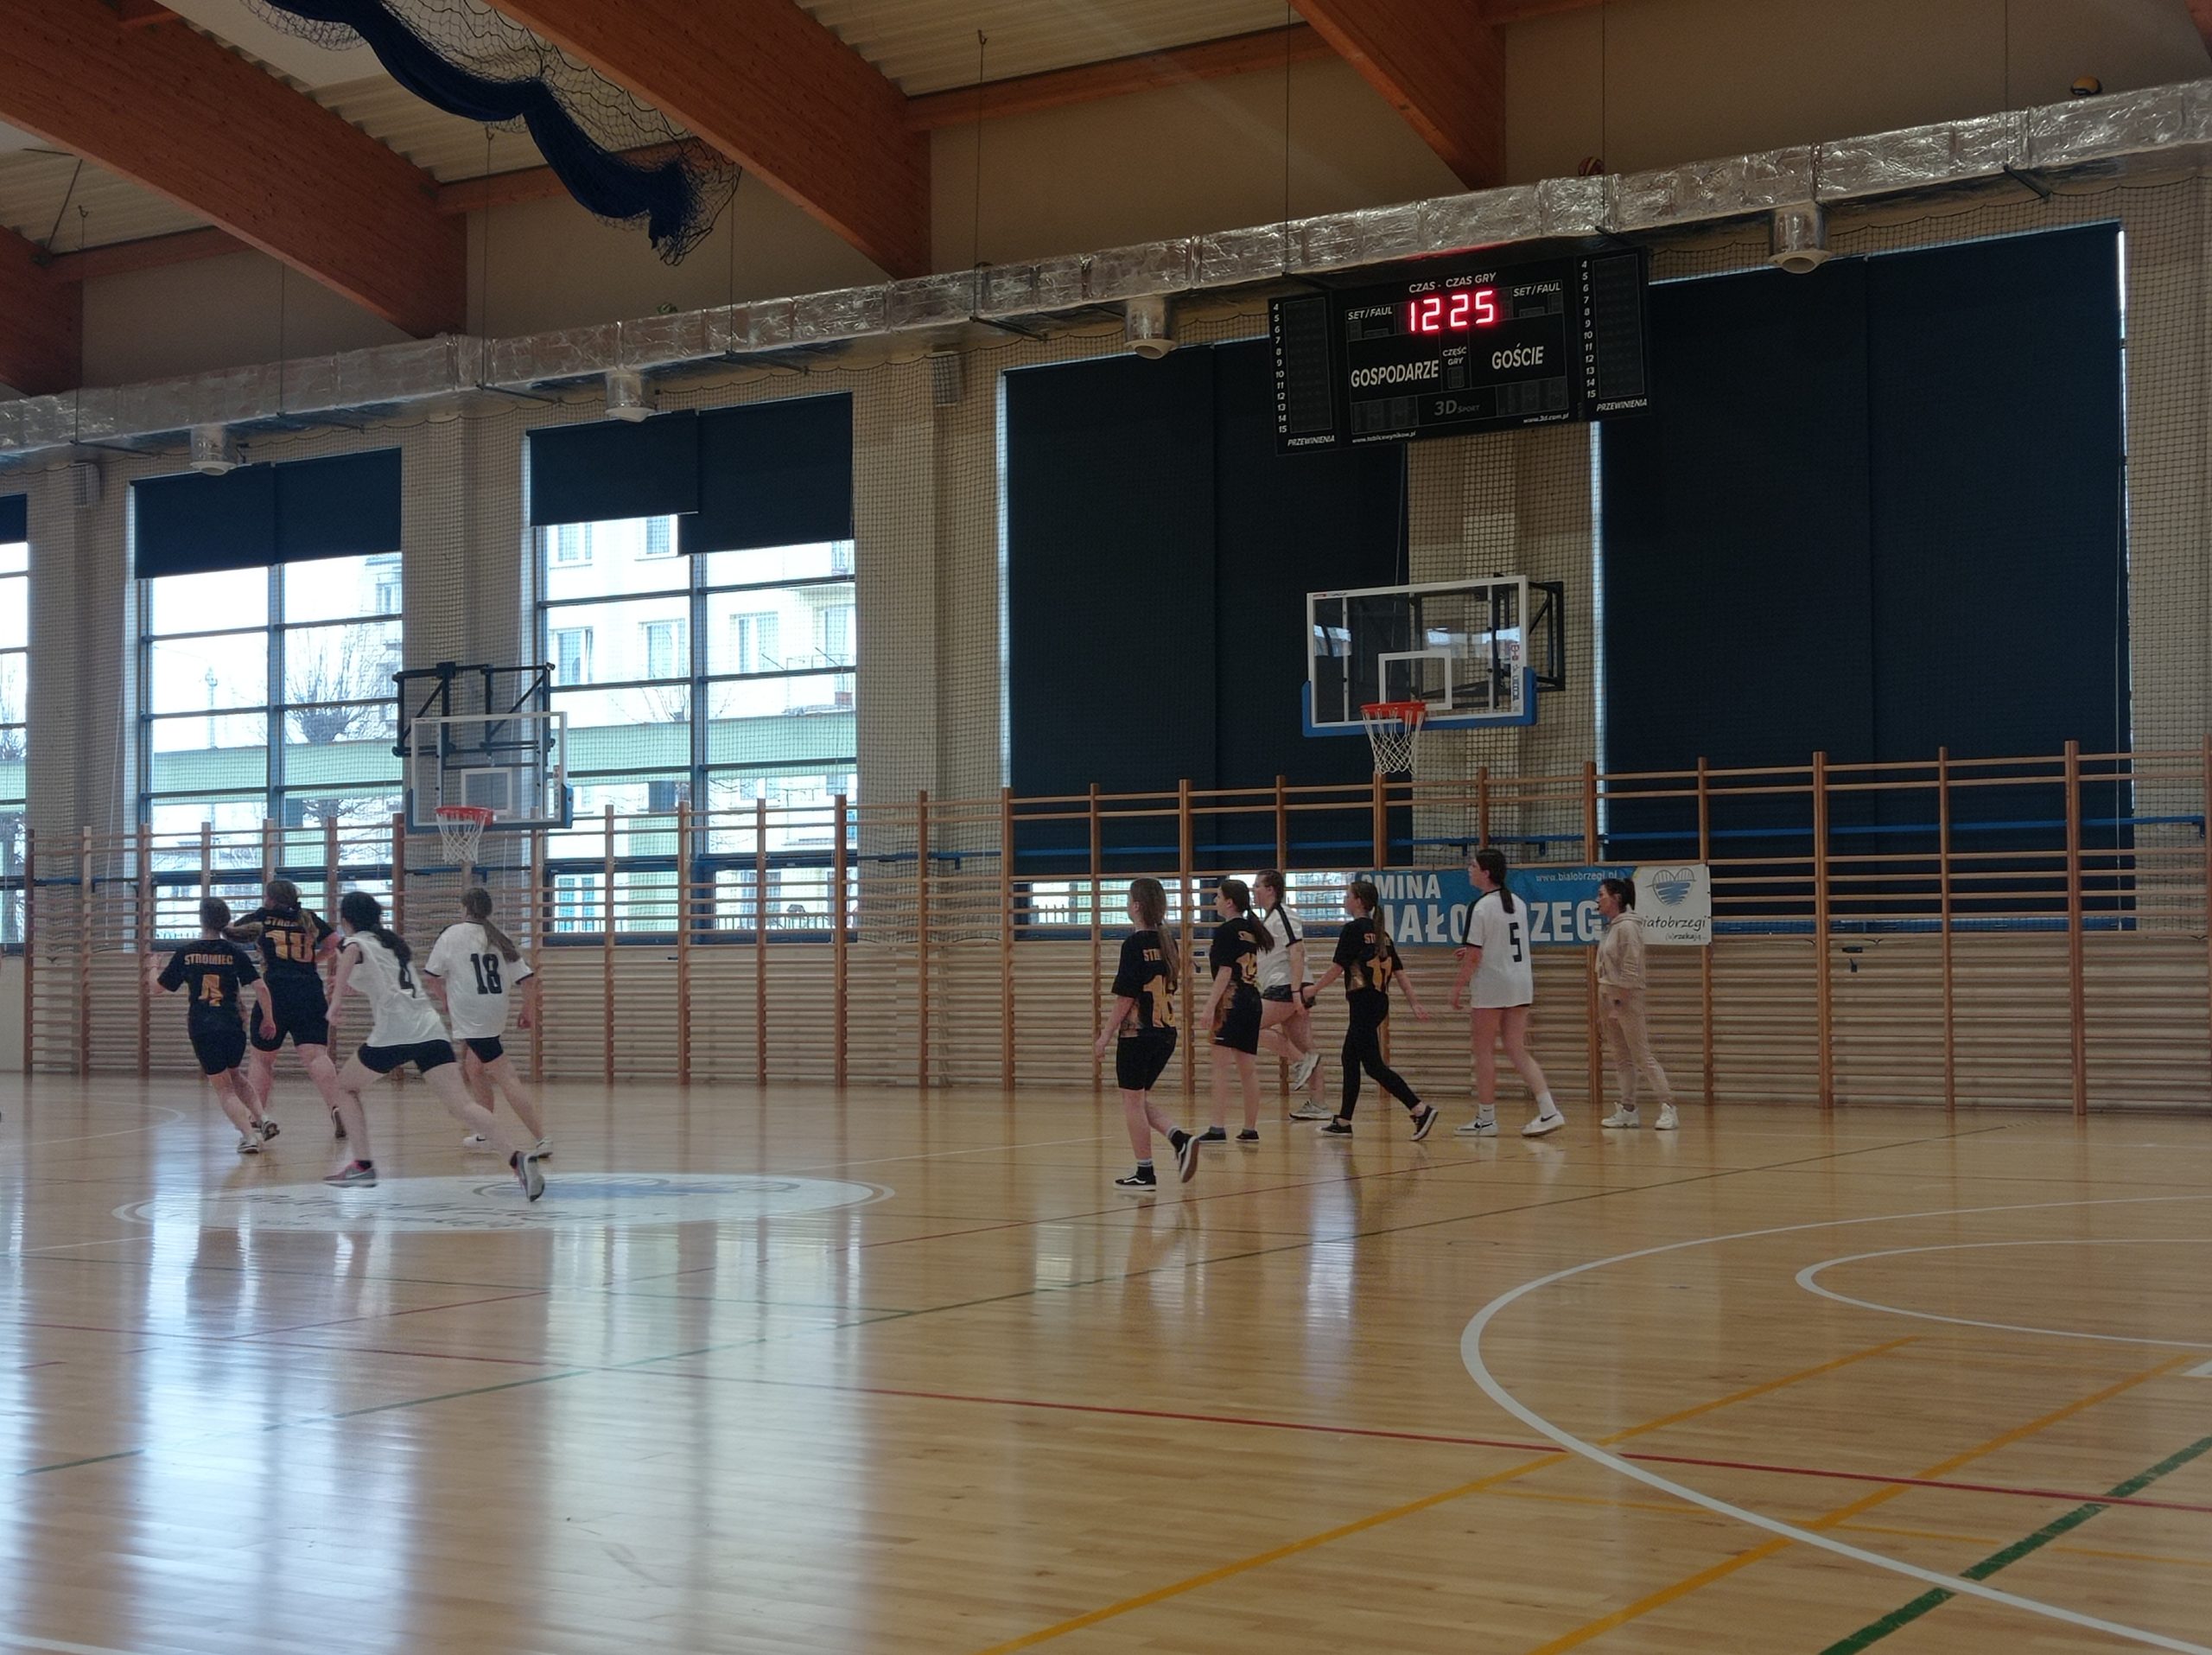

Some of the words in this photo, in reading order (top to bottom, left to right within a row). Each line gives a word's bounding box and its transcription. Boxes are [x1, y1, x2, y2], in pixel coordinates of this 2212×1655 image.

[1581, 260, 1588, 269] 4
[1581, 271, 1588, 280] 5
[1408, 281, 1436, 294] CZAS
[1446, 275, 1472, 288] CZAS
[1474, 271, 1497, 284] GRY
[1582, 283, 1589, 292] 6
[1583, 296, 1590, 304] 7
[1584, 308, 1591, 316] 8
[1274, 314, 1280, 322] 5
[1585, 319, 1592, 328] 9
[1274, 325, 1281, 334] 6
[1585, 342, 1593, 351] 11
[1275, 347, 1282, 356] 8
[1442, 346, 1467, 358] CZĘŚĆ
[1491, 342, 1544, 370] GOŚCIE
[1447, 357, 1465, 366] GRY
[1585, 354, 1594, 363] 12
[1275, 370, 1285, 379] 10
[1351, 359, 1440, 388] GOSPODARZE
[1586, 378, 1596, 386] 14
[1586, 390, 1597, 398] 15
[1277, 403, 1287, 411] 13
[1596, 398, 1648, 412] PRZEWINIENIA
[1277, 414, 1287, 423] 14
[1287, 435, 1336, 447] PRZEWINIENIA
[1643, 915, 1707, 933] iałobrzegi
[1509, 921, 1522, 963] 5
[470, 953, 503, 995] 18
[198, 974, 224, 1008] 4
